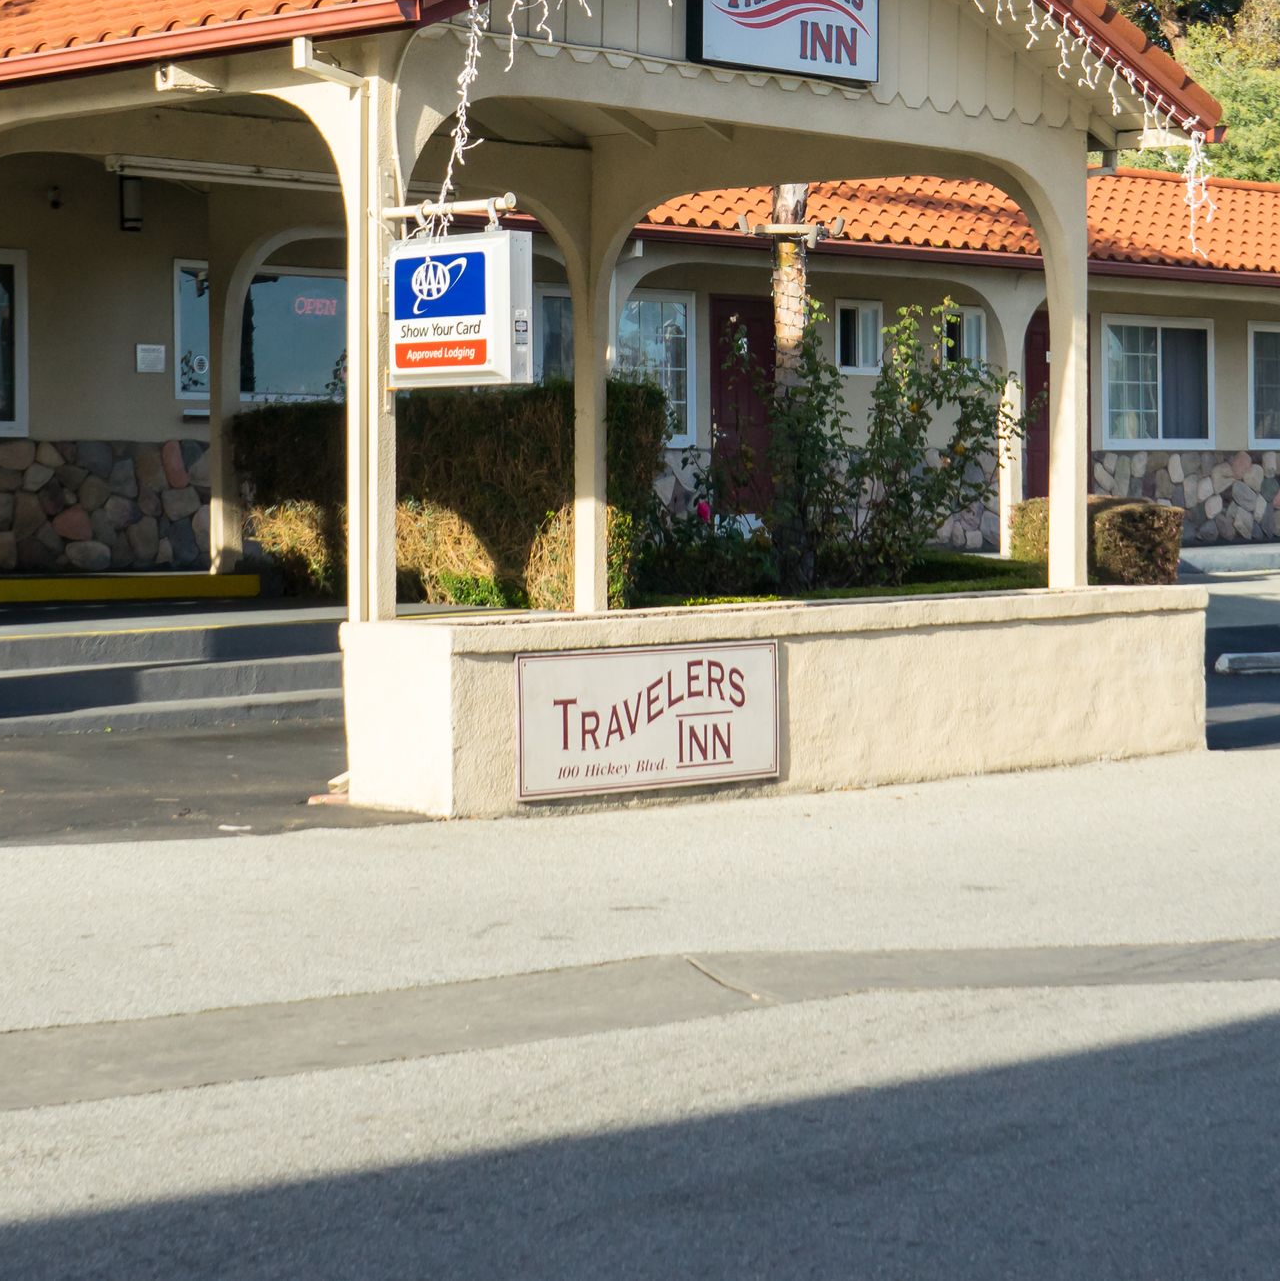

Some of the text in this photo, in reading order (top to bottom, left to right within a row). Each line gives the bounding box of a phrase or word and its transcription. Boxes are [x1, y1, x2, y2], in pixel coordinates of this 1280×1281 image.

[799, 20, 858, 66] INN
[413, 262, 449, 299] AAA
[294, 296, 337, 316] OPEN
[400, 319, 482, 339] Show Your Card
[406, 346, 476, 362] Approved Lodging
[553, 659, 746, 751] TRAVELERS
[678, 719, 732, 763] INN
[558, 757, 668, 779] 100 Hickey Blvd.
